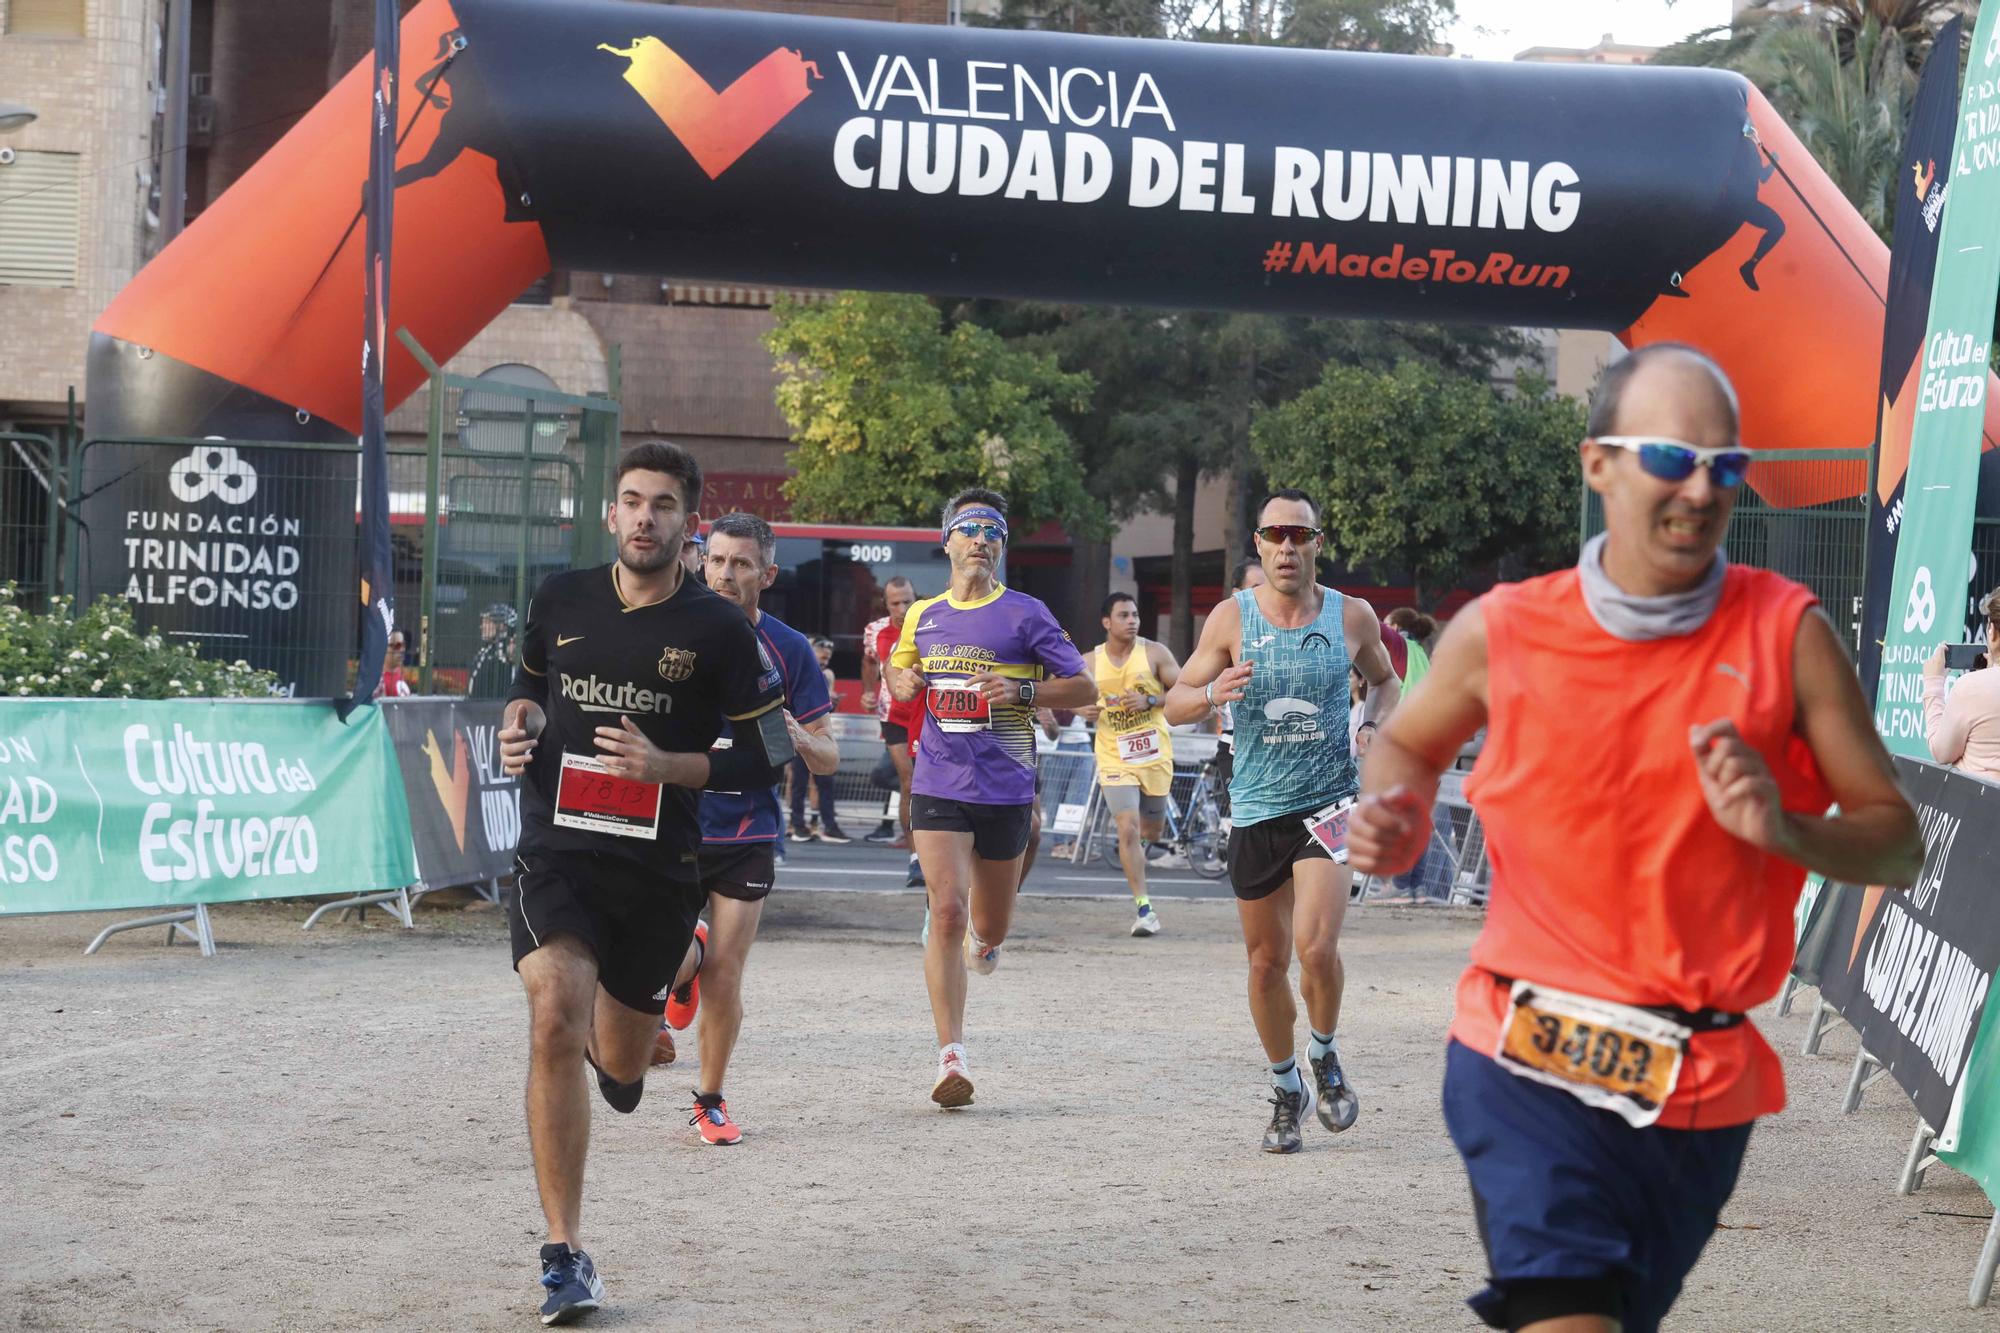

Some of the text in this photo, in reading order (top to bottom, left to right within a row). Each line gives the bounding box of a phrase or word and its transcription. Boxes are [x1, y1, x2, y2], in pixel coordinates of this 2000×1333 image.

[837, 51, 1176, 132] VALENCIA
[833, 116, 1581, 233] CIUDAD DEL RUNNING
[1263, 240, 1571, 289] #MadeToRun
[127, 511, 299, 536] FUNDACIÓN
[124, 538, 300, 576] TRINIDAD
[851, 545, 892, 562] 9009
[124, 573, 298, 611] ALFONSO
[928, 644, 996, 661] ELS SITGES
[560, 672, 673, 714] Rakuten
[935, 690, 978, 712] 2780
[124, 723, 316, 795] Cultura del
[1128, 738, 1151, 752] 269
[139, 799, 318, 882] Esfuerzo
